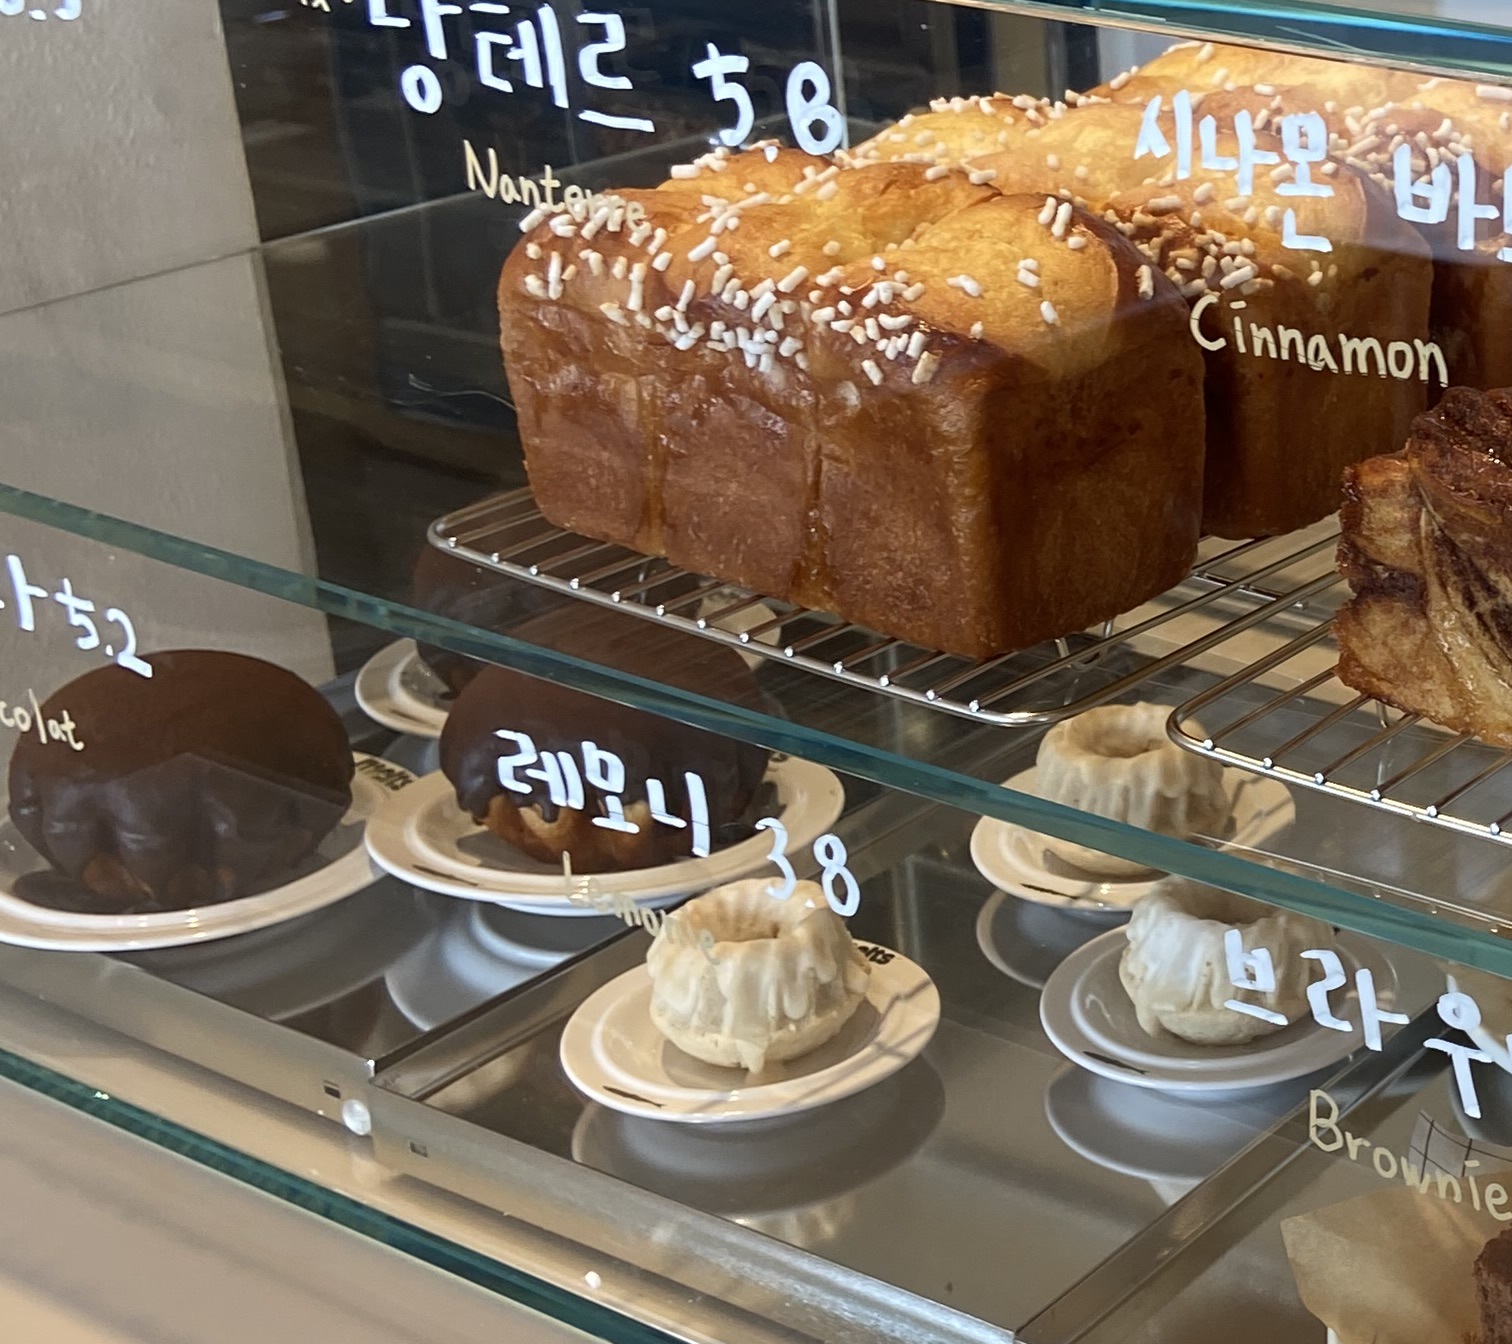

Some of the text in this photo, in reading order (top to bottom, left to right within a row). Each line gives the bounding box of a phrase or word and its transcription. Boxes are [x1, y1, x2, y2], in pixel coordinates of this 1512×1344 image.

[1134, 89, 1334, 253] 시나몬
[1190, 292, 1449, 388] Cinnamon
[54, 578, 153, 678] 5.2
[496, 729, 712, 857] 레모니
